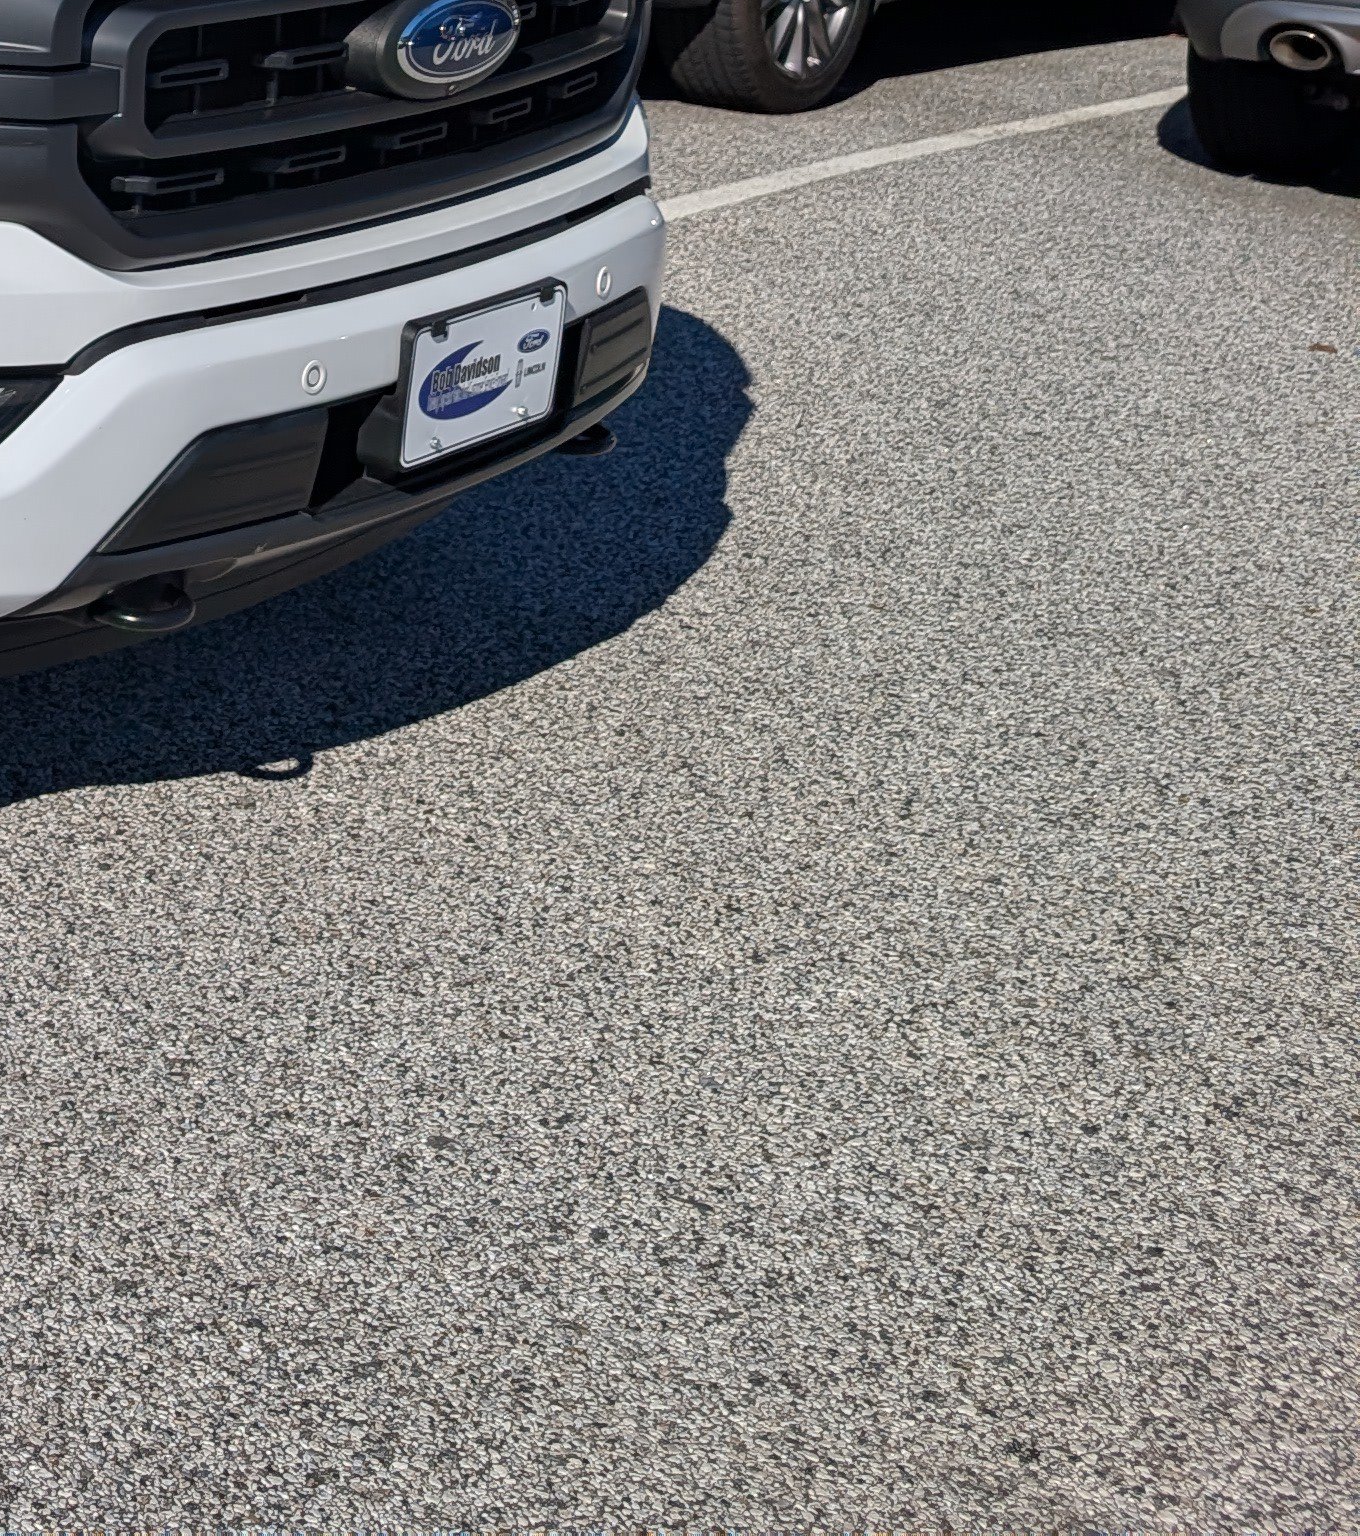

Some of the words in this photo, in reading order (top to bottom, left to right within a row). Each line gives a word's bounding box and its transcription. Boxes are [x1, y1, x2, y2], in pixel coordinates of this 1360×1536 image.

[431, 13, 500, 66] Ford
[522, 332, 545, 350] Ford
[431, 367, 454, 393] Bob
[454, 354, 501, 384] Davidson
[524, 362, 546, 377] LINCOLN
